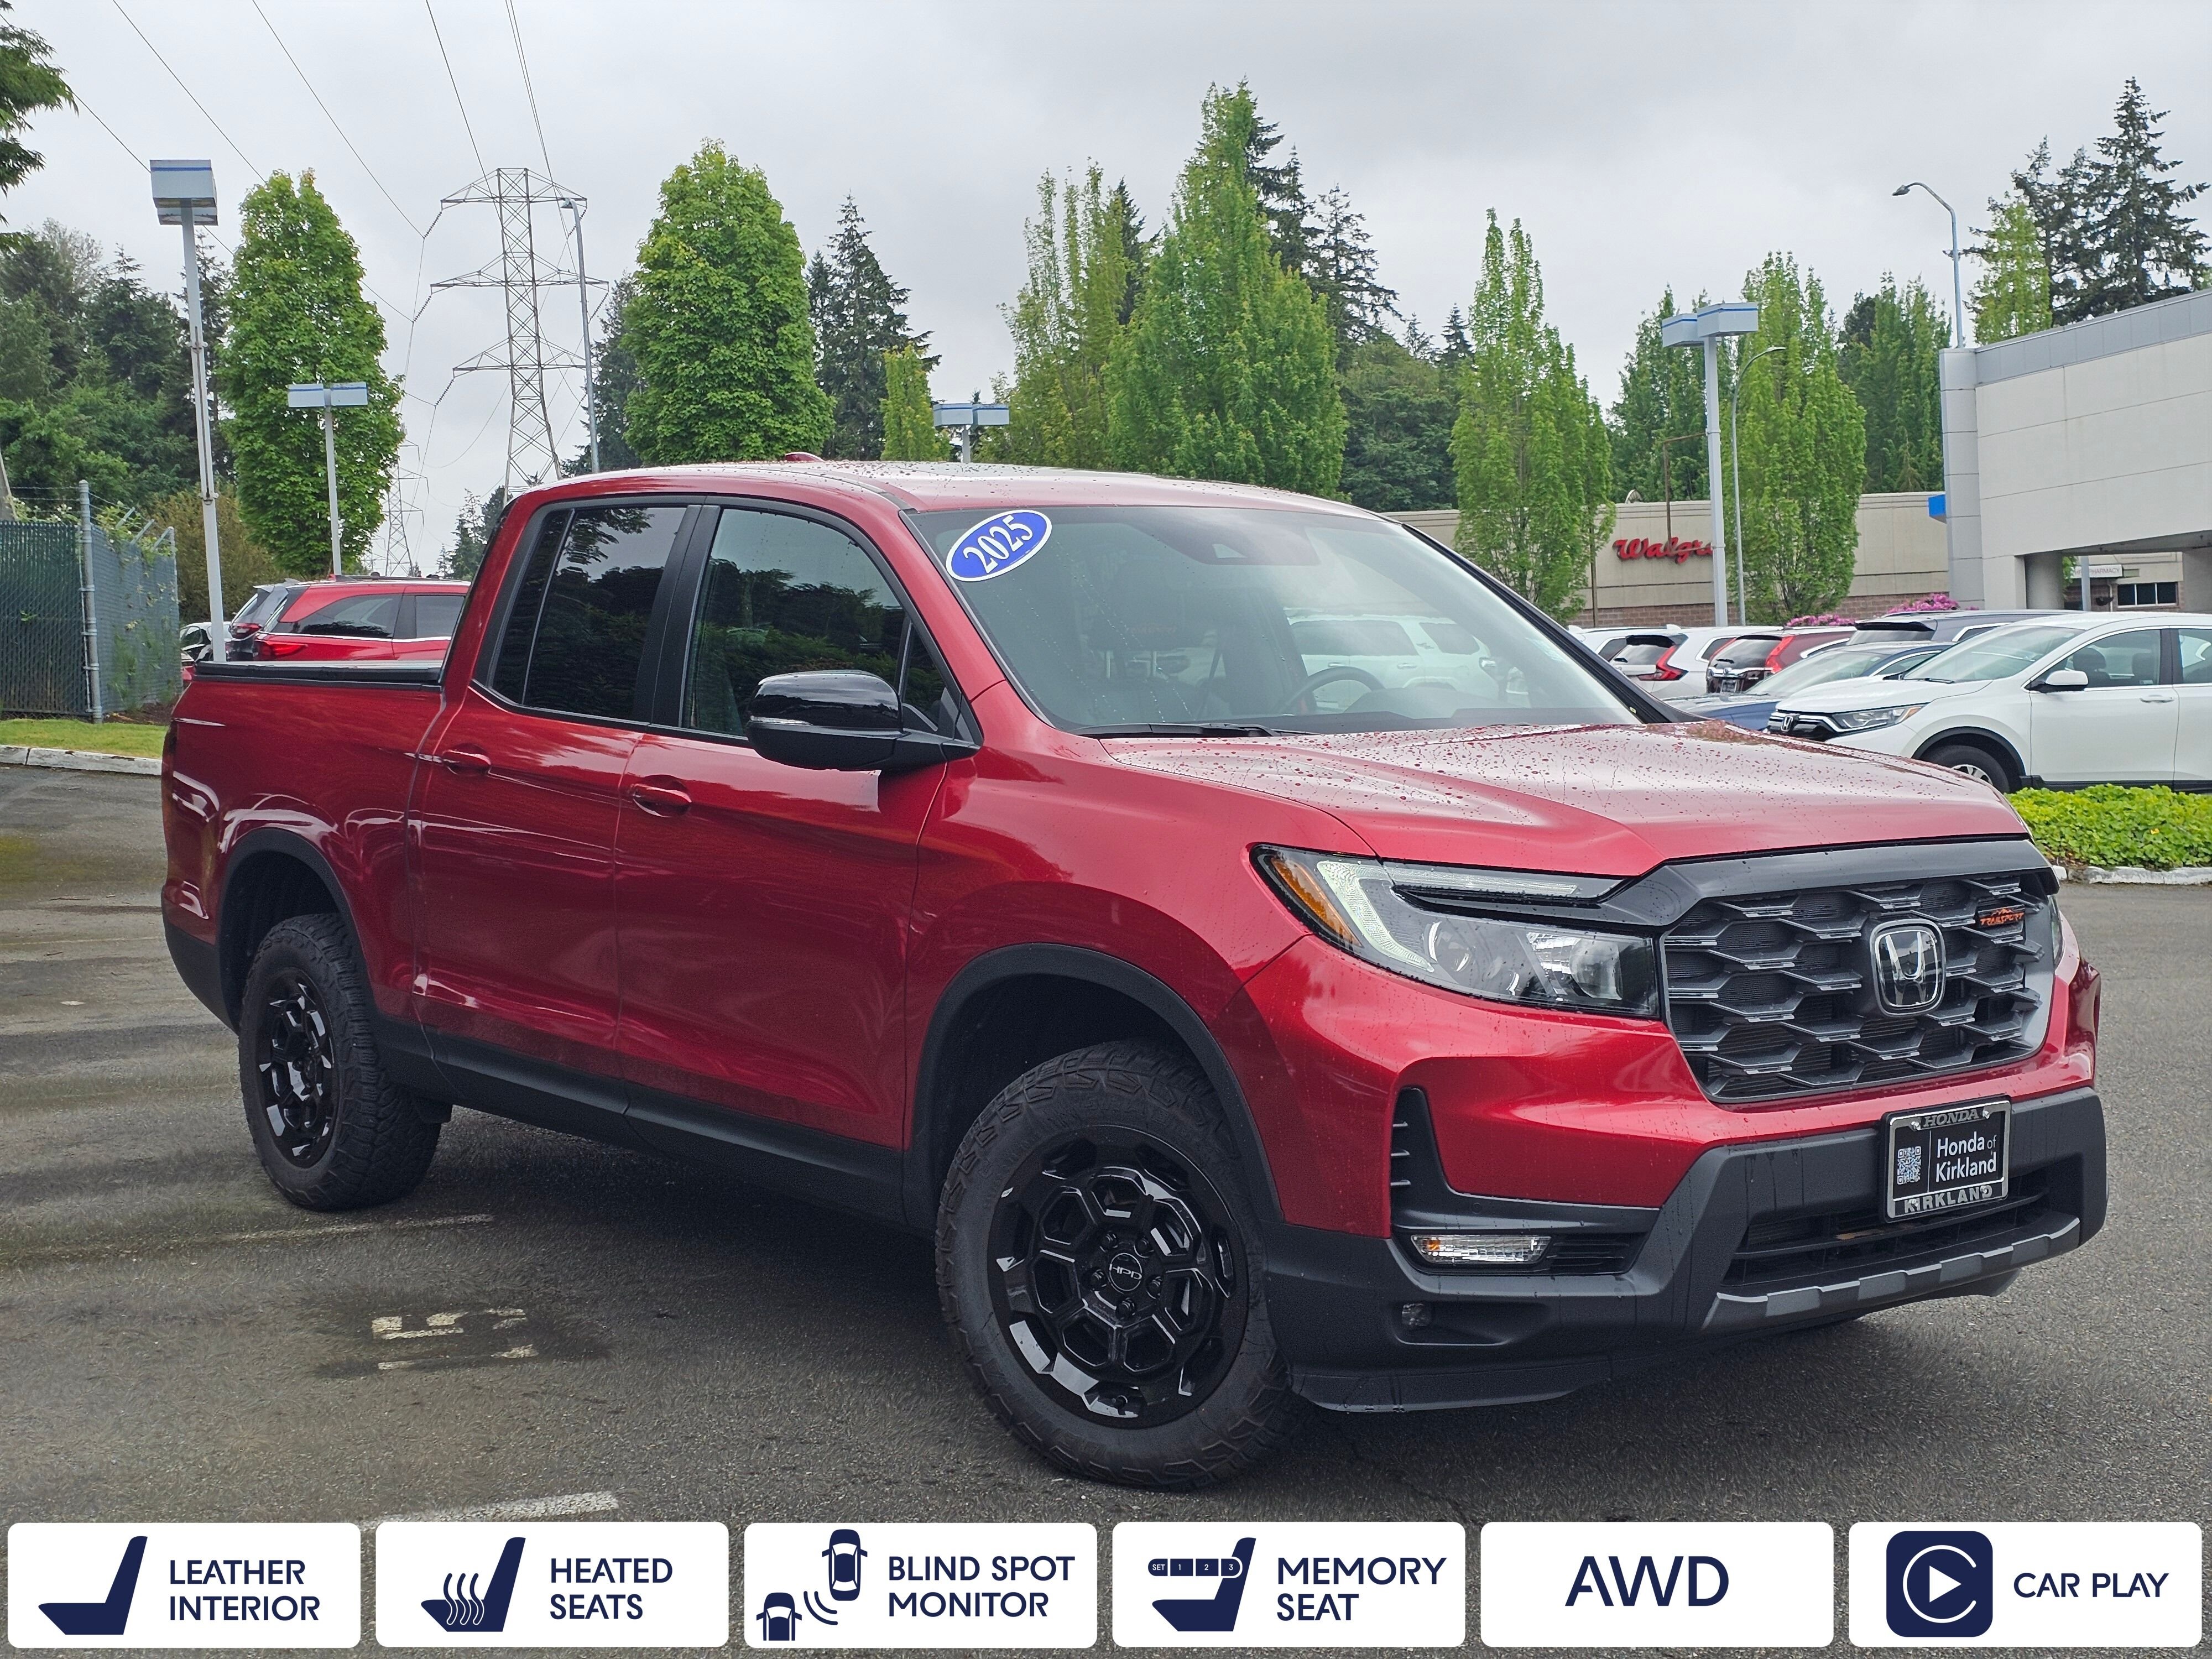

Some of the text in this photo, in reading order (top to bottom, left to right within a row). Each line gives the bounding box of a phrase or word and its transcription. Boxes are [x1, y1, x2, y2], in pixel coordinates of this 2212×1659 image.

[963, 515, 1033, 573] 2025
[1923, 1108, 1980, 1128] HONDA
[1937, 1131, 1997, 1158] Honda of
[1936, 1151, 1997, 1182] Kirkland
[1109, 1264, 1142, 1280] HPD
